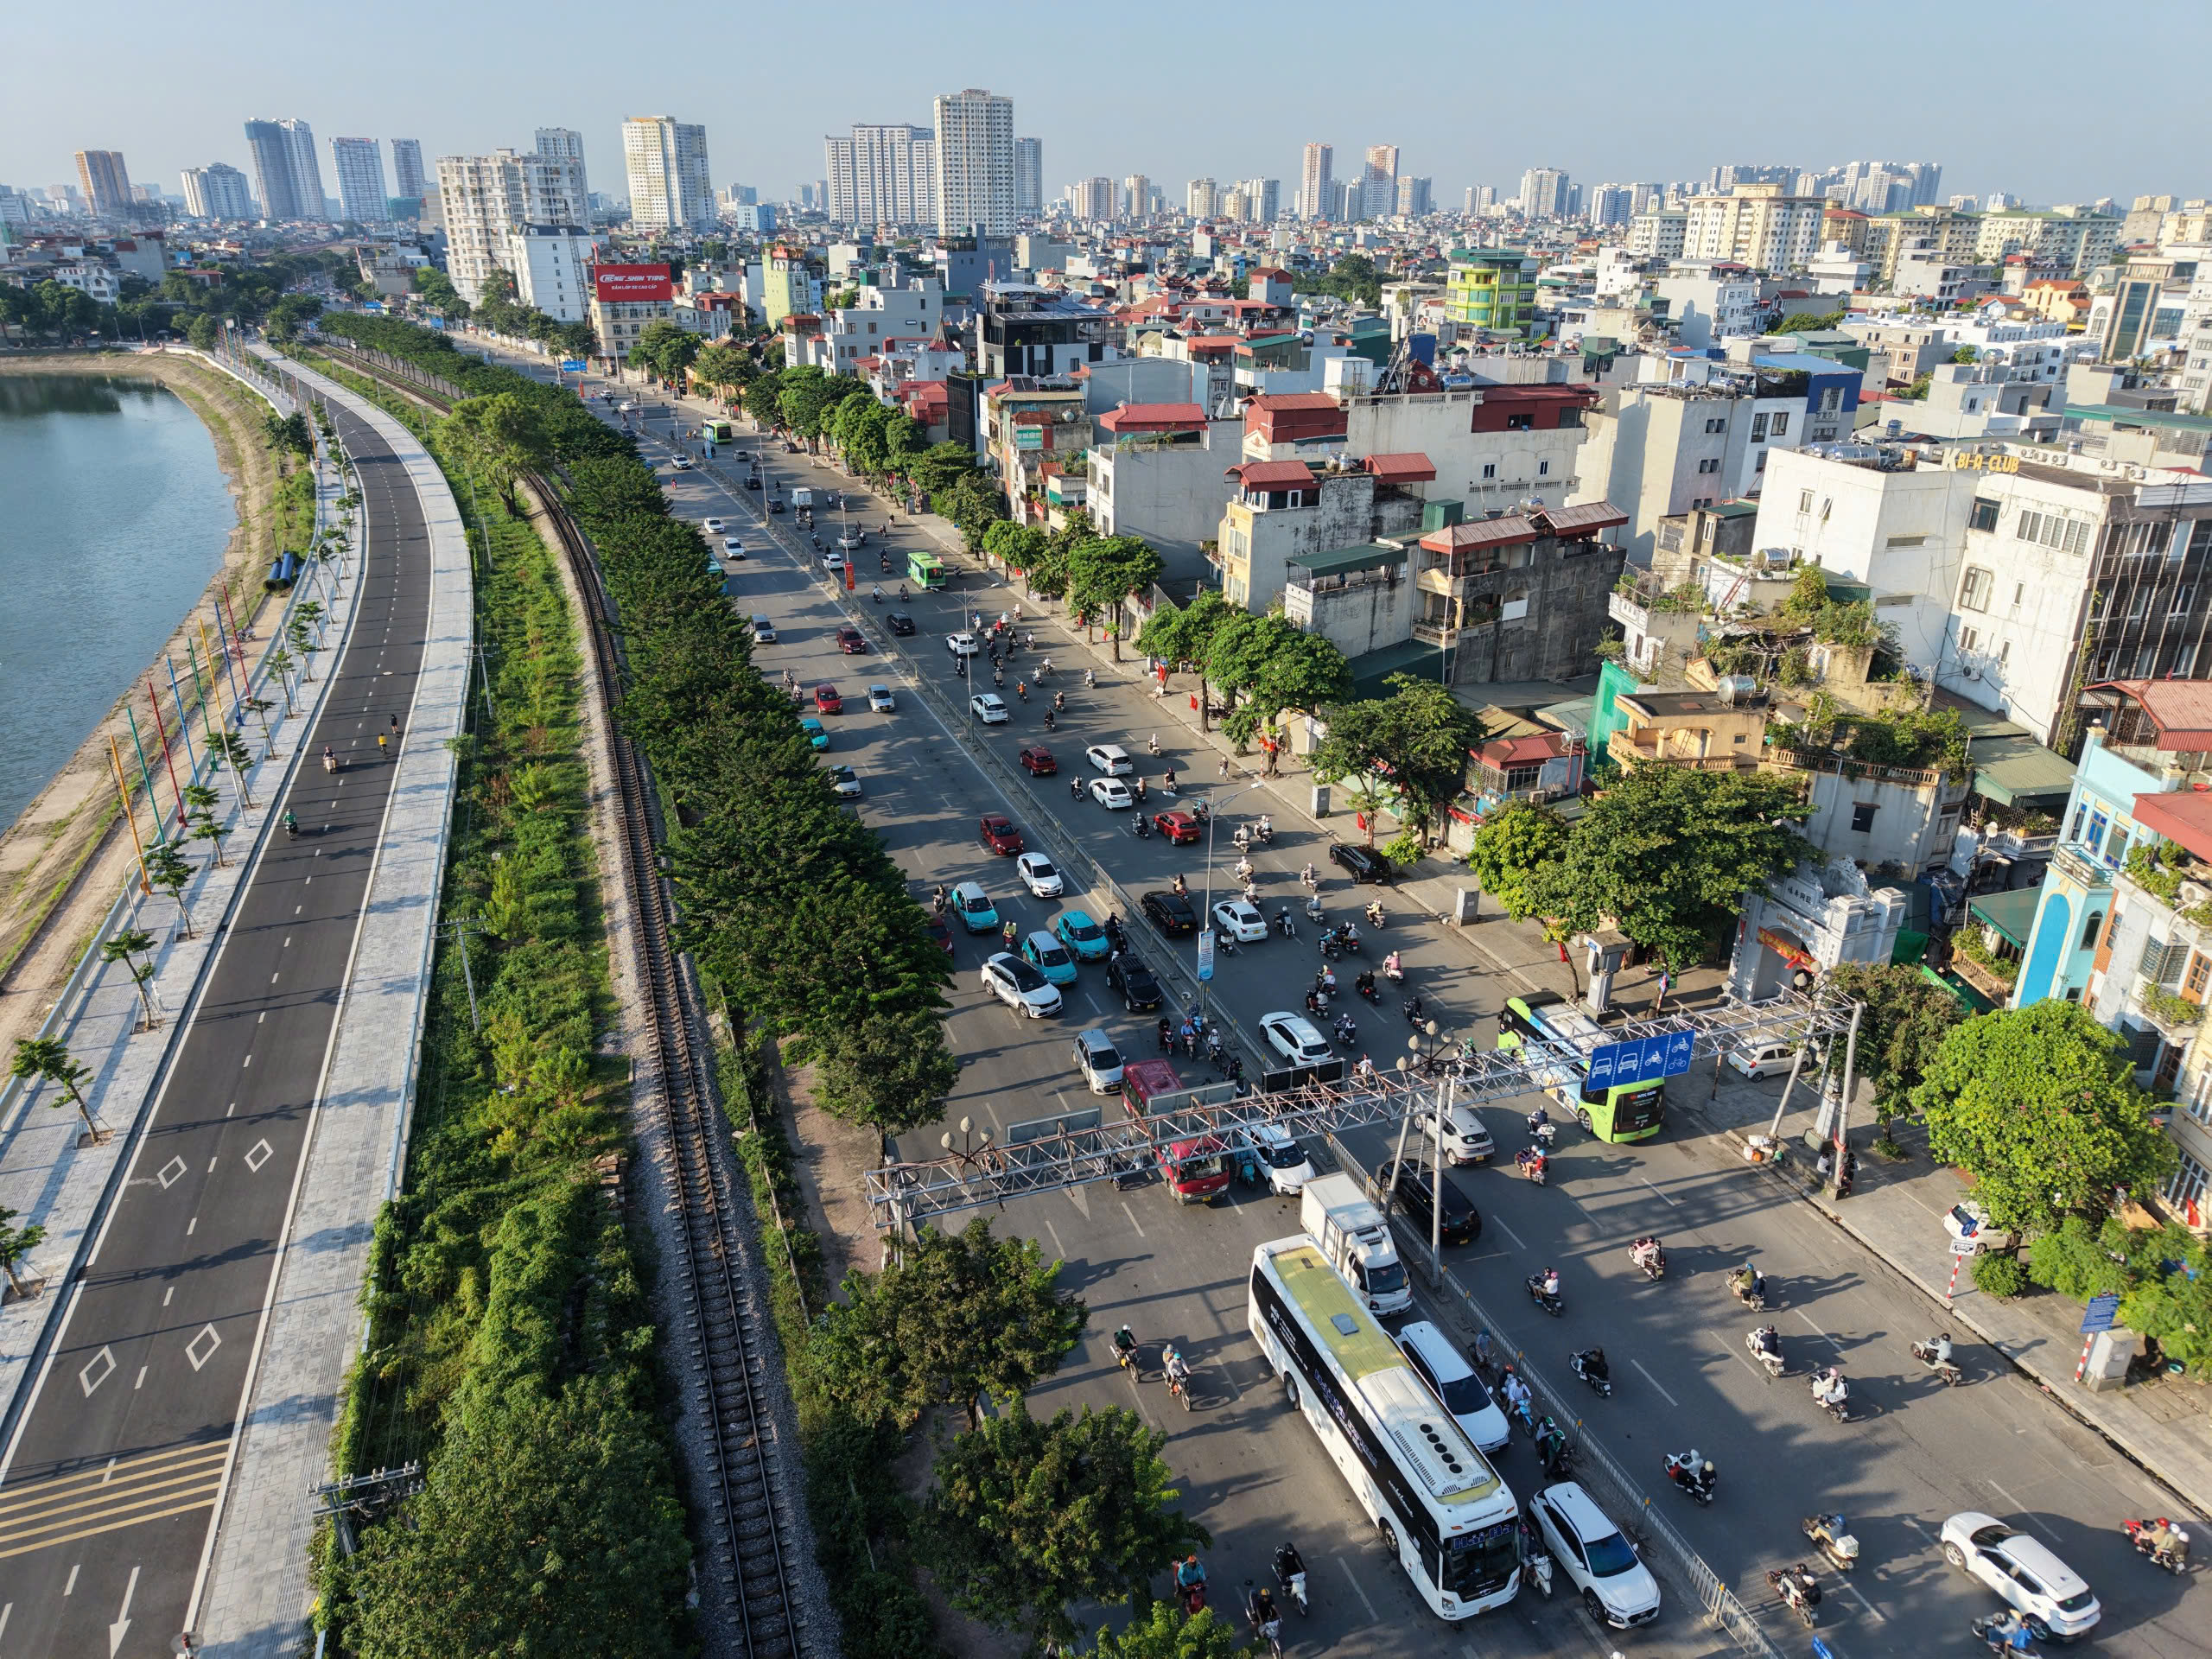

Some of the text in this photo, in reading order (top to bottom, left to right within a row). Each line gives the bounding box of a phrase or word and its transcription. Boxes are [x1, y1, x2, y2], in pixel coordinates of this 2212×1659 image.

[1942, 447, 2019, 473] K BI-A CLUB
[1962, 1223, 1976, 1235] 20
